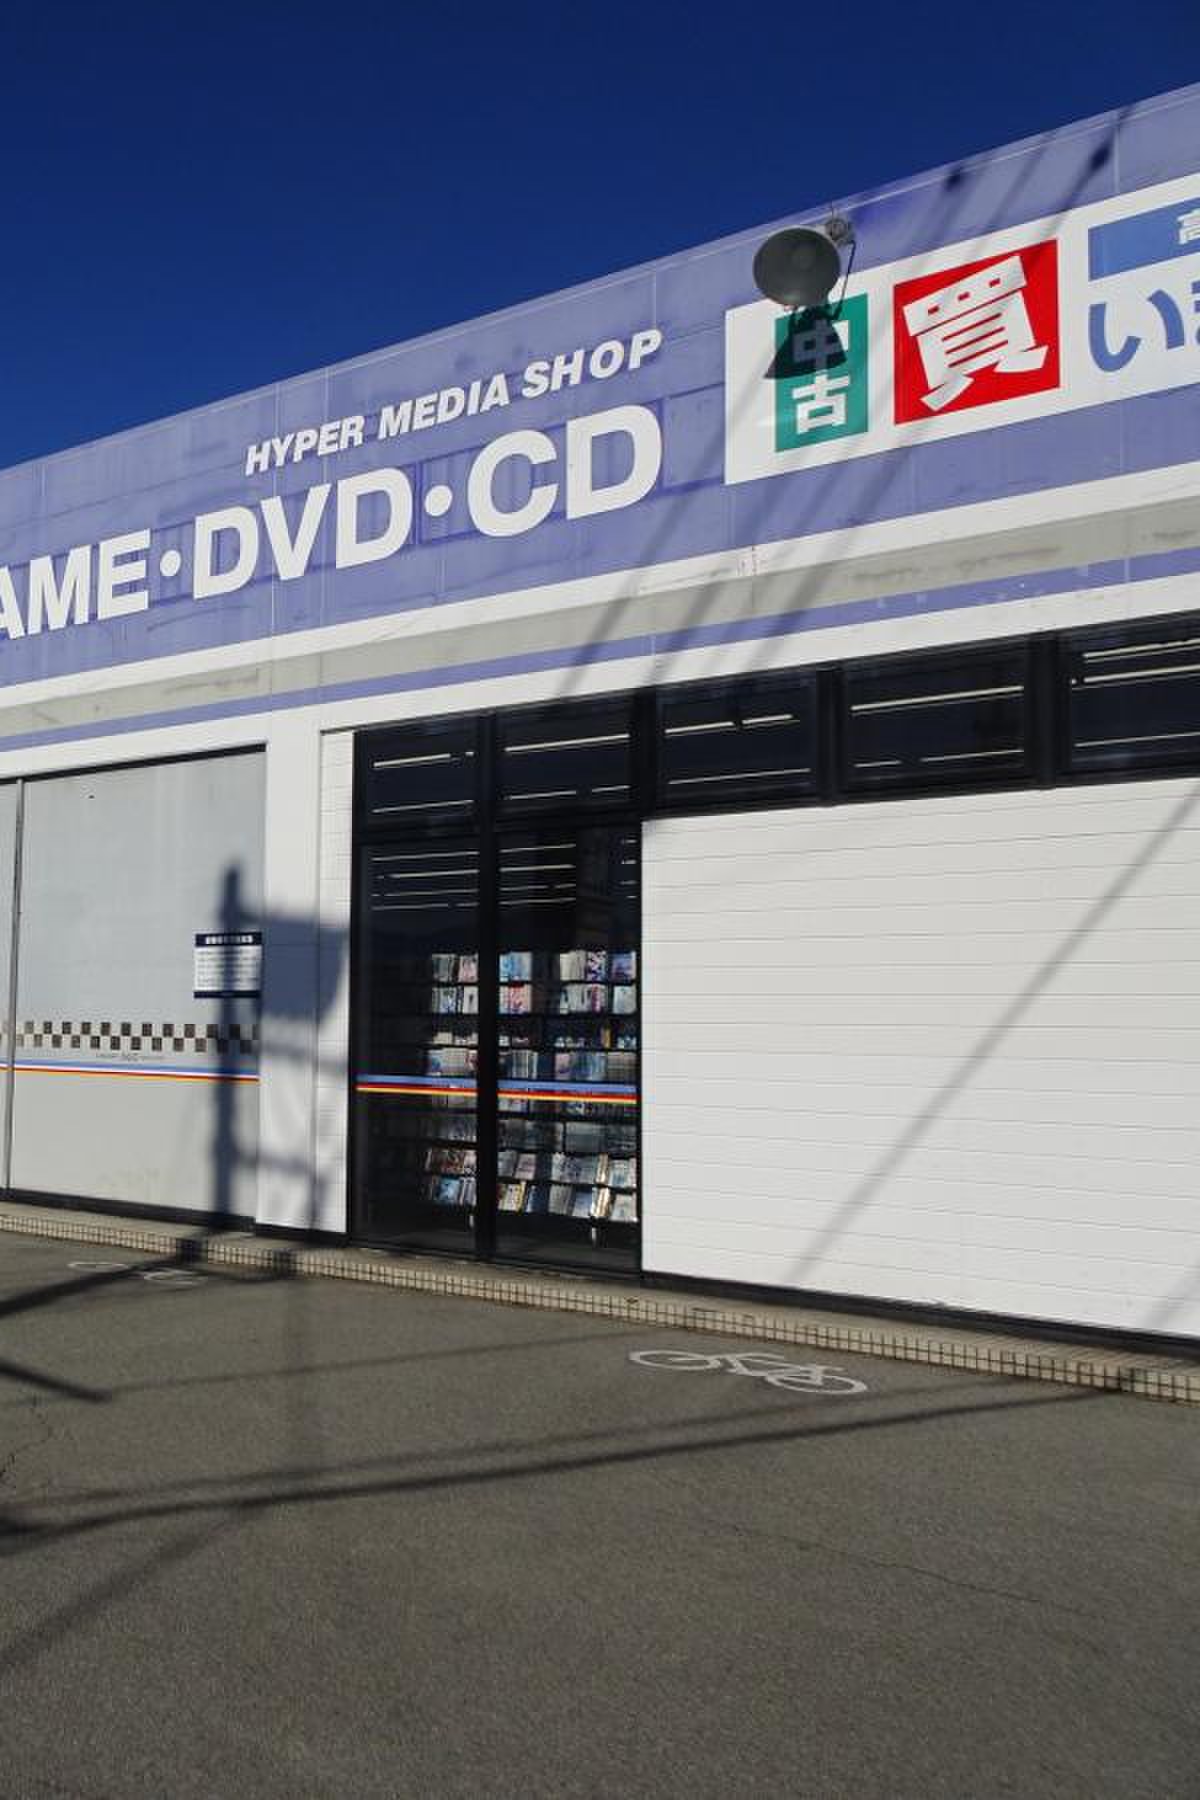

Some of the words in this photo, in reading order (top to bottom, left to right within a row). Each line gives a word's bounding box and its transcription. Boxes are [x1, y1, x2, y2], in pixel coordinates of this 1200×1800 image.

[245, 414, 365, 477] HYPER
[377, 372, 510, 441] MEDIA
[521, 328, 663, 399] SHOP
[902, 255, 1050, 412] 買
